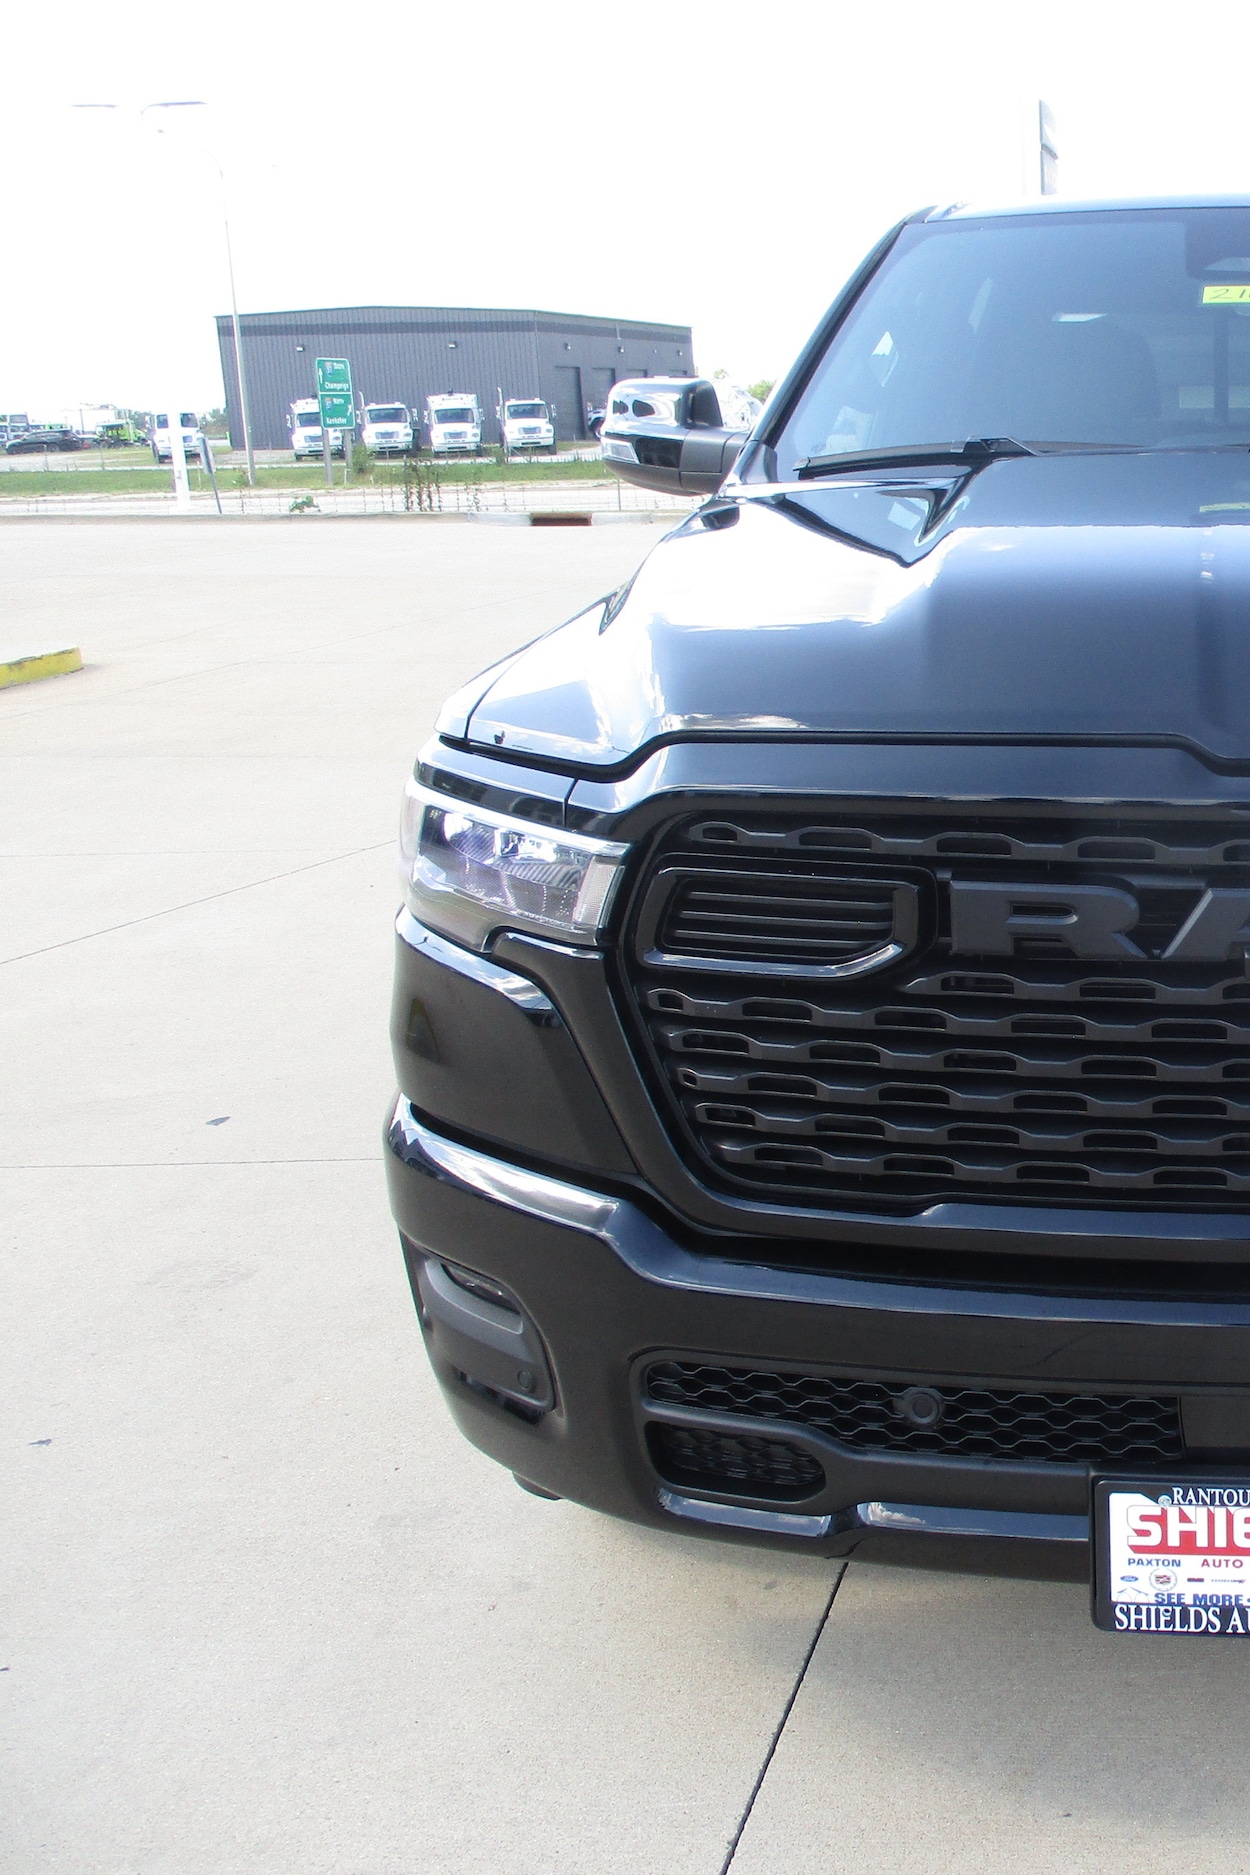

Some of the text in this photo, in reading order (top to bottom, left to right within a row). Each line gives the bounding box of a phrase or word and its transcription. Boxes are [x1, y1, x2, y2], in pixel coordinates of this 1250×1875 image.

[1127, 1558, 1181, 1567] PAXTON
[1201, 1559, 1244, 1569] AUTO
[1154, 1593, 1186, 1605] SEE
[1193, 1594, 1243, 1606] MORE
[1114, 1604, 1222, 1633] SHIELDS
